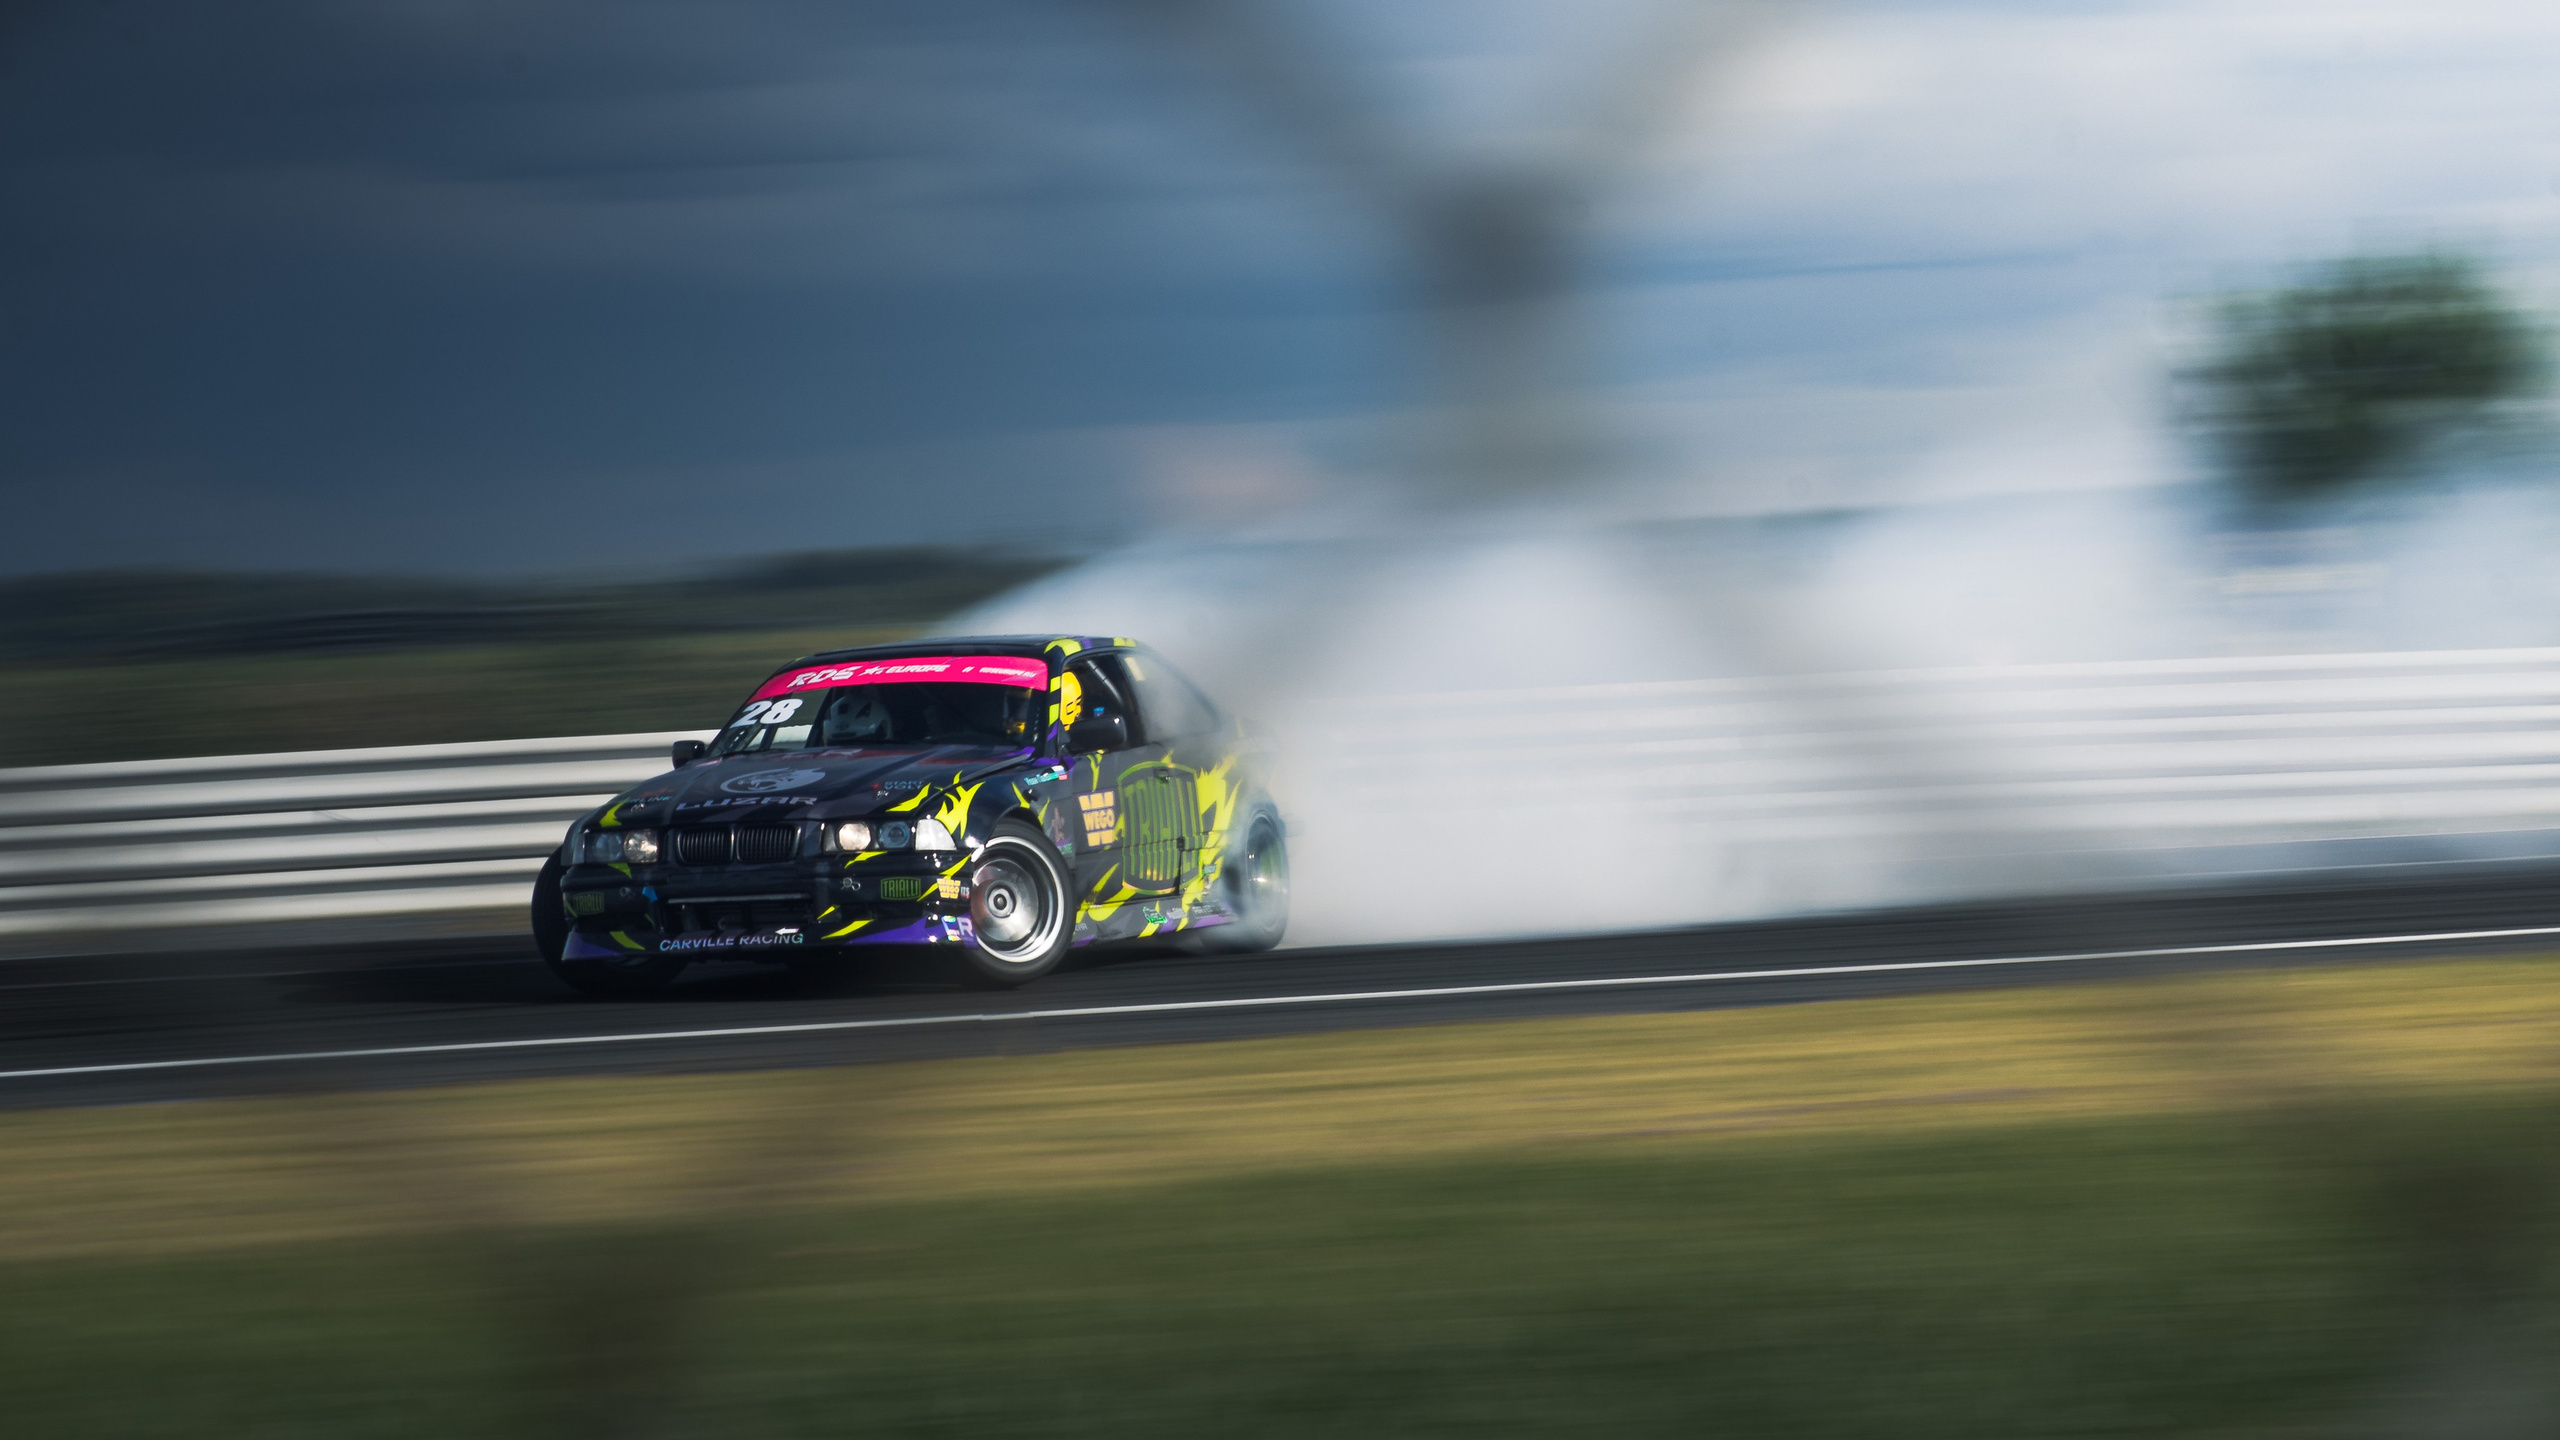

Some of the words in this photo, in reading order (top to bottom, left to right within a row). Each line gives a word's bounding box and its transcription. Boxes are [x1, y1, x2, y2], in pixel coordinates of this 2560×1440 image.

[786, 665, 863, 689] RDS
[885, 664, 951, 674] EUROPE
[728, 698, 804, 729] 28
[676, 796, 818, 811] LUZAR
[1082, 808, 1116, 832] WEGO
[1124, 777, 1199, 881] TRIALLI
[882, 879, 919, 898] TRIALLI
[659, 937, 735, 951] CARVILLE
[738, 932, 804, 946] RACING
